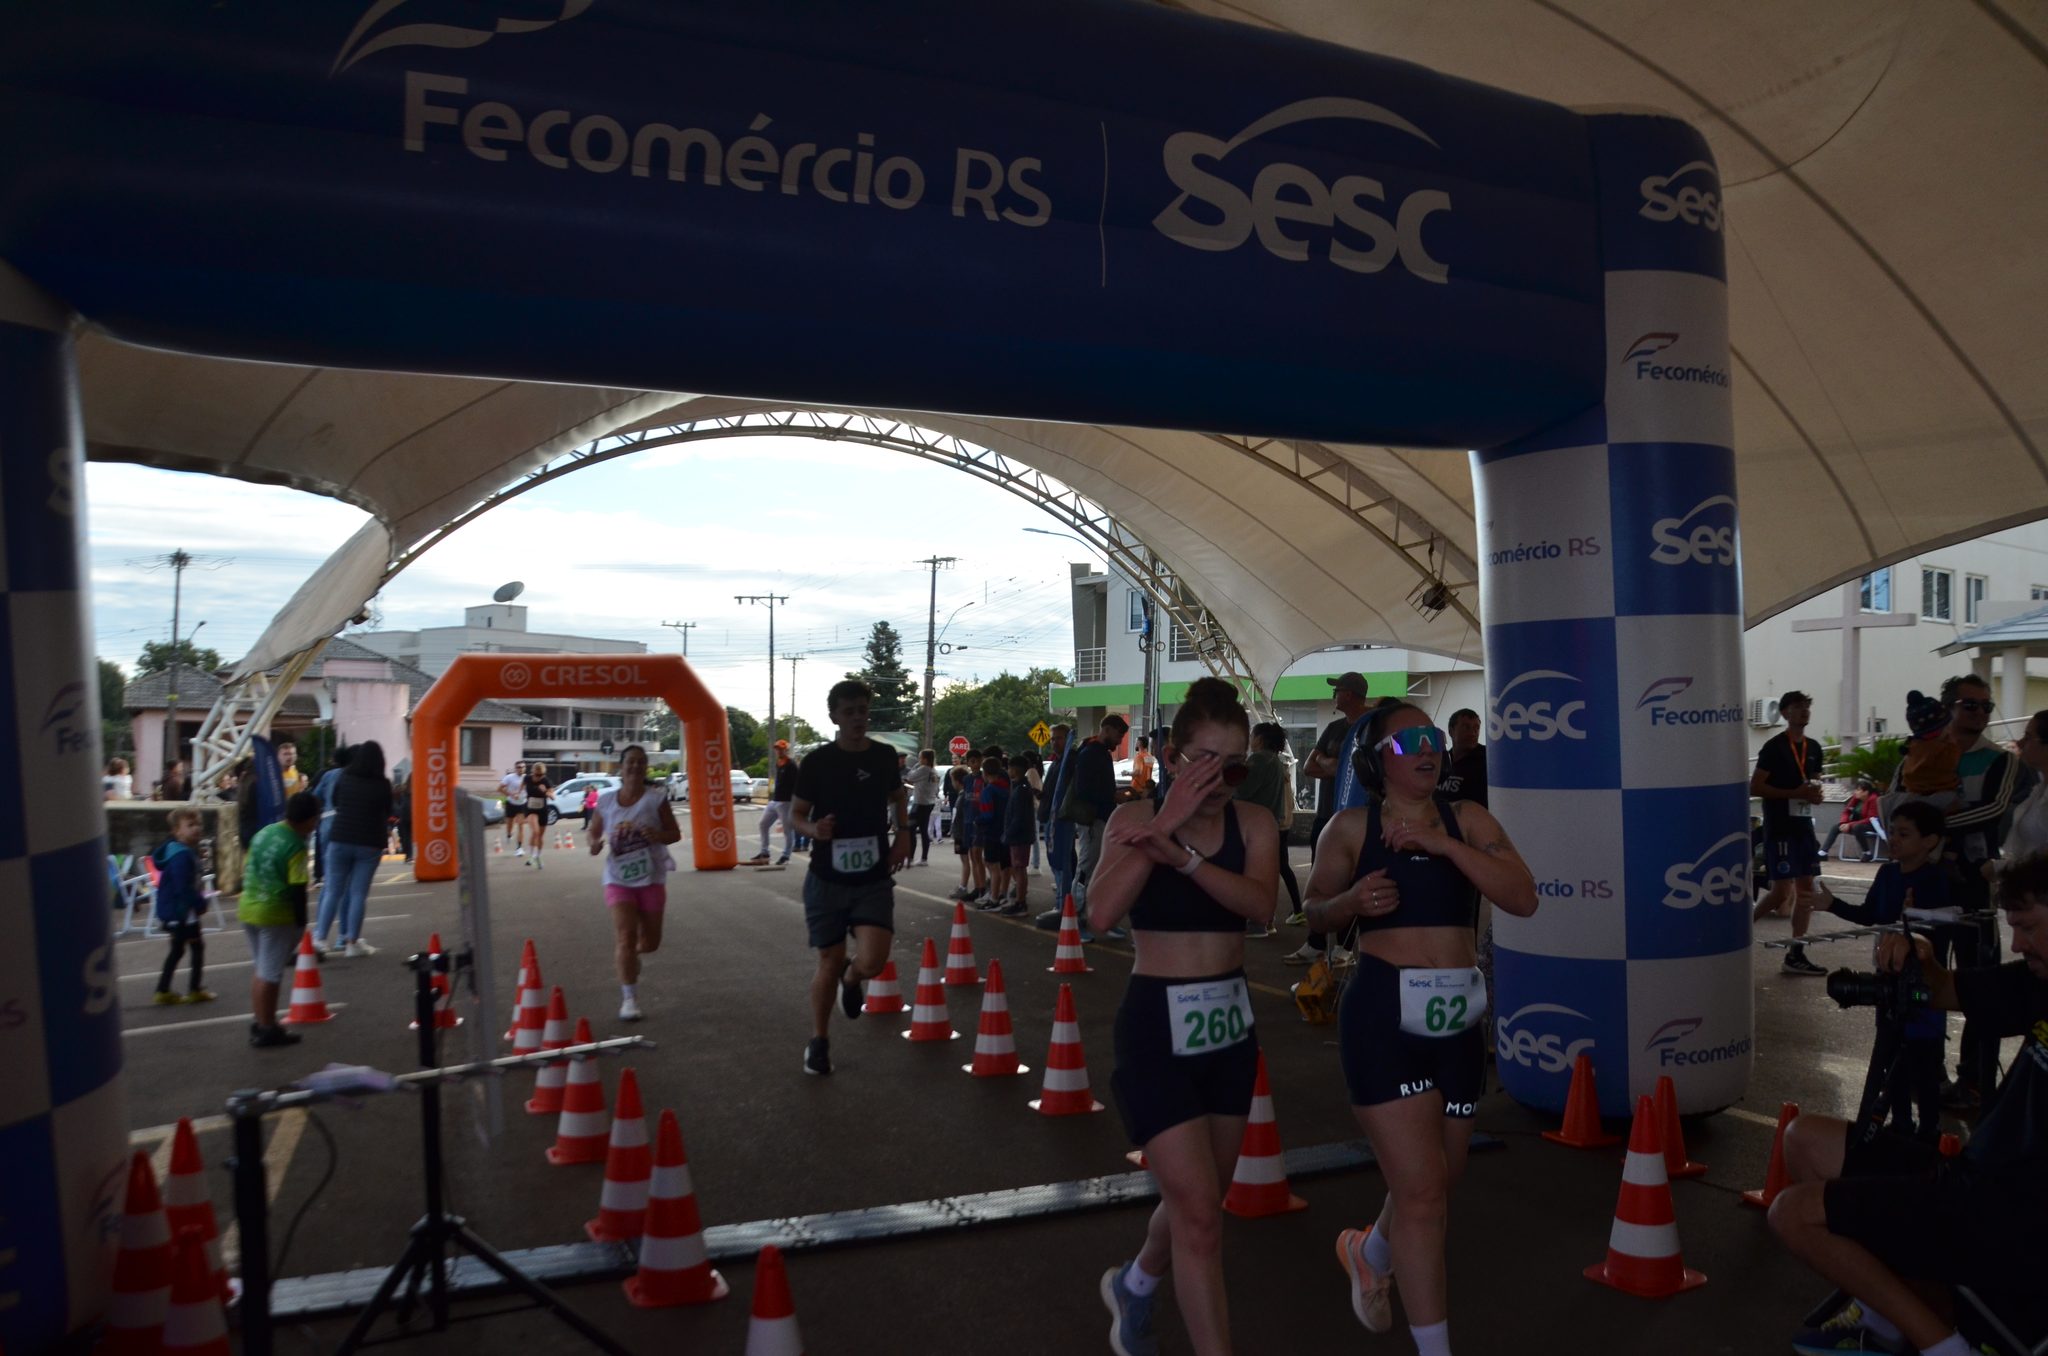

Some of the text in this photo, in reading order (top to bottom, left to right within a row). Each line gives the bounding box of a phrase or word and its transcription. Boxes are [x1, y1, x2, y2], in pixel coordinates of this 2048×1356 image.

[403, 70, 1053, 227] Fecomércio RS
[1638, 175, 1723, 232] Ses
[1489, 536, 1601, 565] omércio RS
[1649, 518, 1735, 567] Ses
[539, 665, 648, 686] CRESOL
[950, 742, 969, 751] PARE
[428, 740, 448, 833] CRESOL
[706, 733, 729, 822] CRESOL
[839, 849, 873, 870] 103
[1581, 879, 1613, 898] RS
[1184, 1004, 1246, 1049] 260
[1425, 994, 1468, 1032] 62
[1399, 1077, 1435, 1098] RUN
